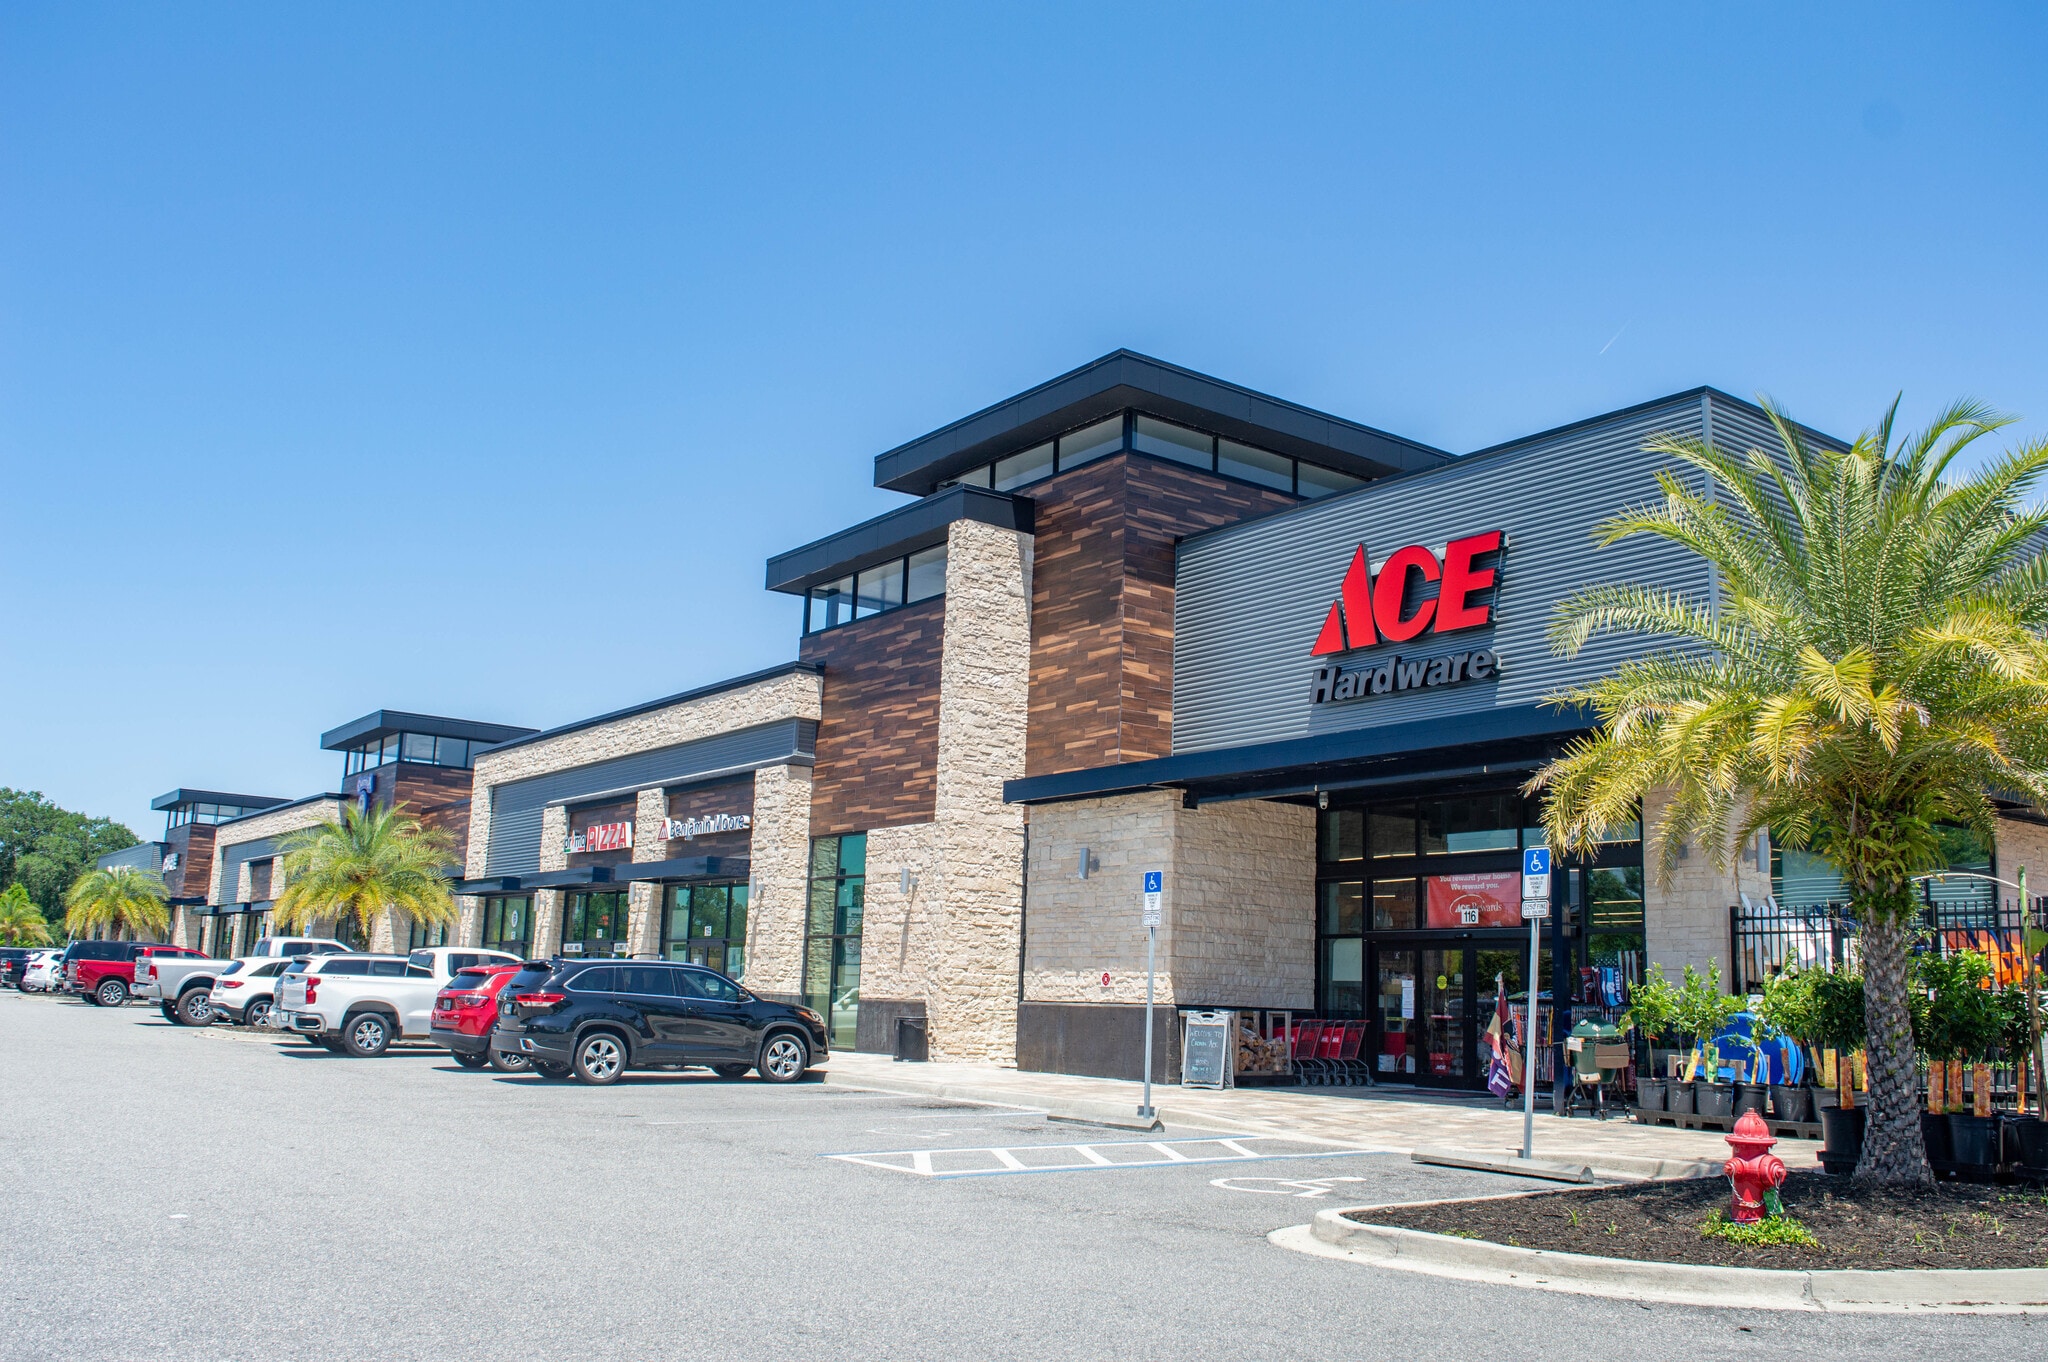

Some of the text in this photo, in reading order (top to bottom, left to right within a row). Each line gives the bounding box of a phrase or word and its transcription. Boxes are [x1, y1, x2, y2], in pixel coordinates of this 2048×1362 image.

[1310, 530, 1503, 656] ACE
[1309, 650, 1498, 703] Hardware
[586, 822, 629, 853] PIZZA
[670, 814, 746, 839] Benjamin Moore
[1477, 874, 1491, 882] your
[1464, 910, 1477, 922] 116
